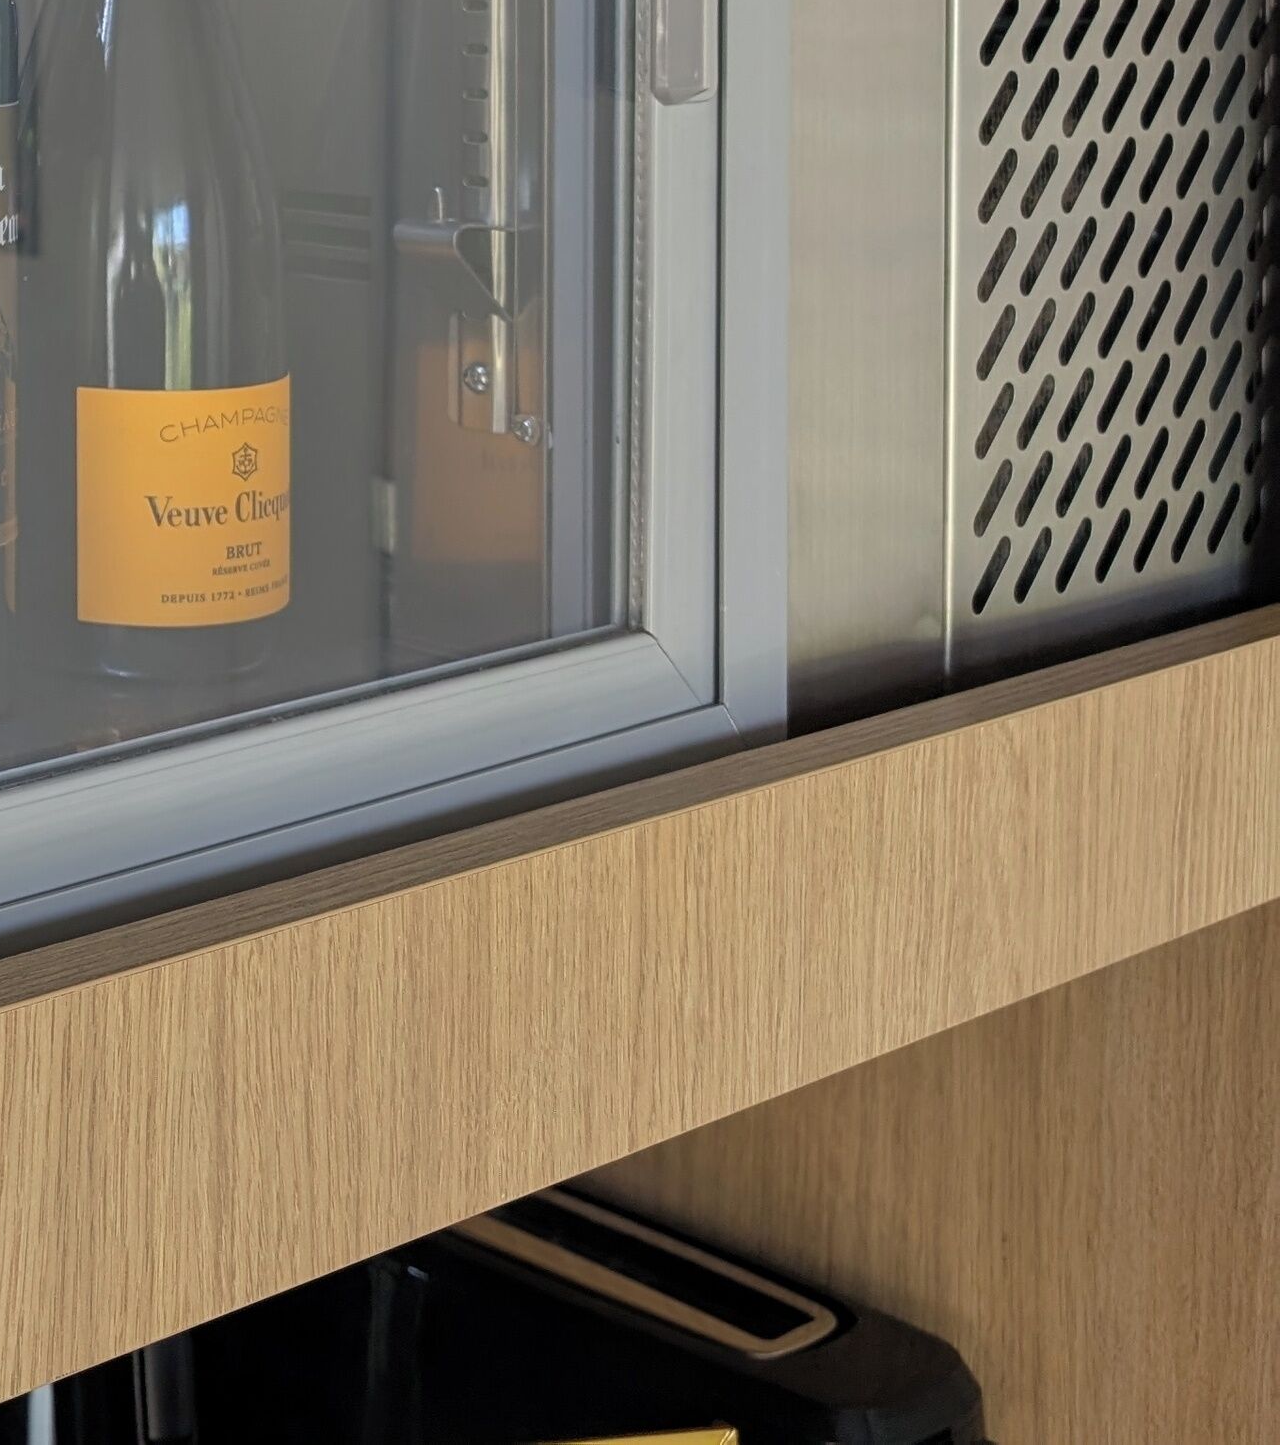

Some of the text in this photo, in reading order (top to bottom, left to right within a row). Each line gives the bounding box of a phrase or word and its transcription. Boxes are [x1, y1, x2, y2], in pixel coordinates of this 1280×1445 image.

[144, 495, 228, 527] Veuve
[226, 541, 262, 560] BRUT
[161, 593, 206, 603] DEPUIS
[211, 591, 235, 602] 1772
